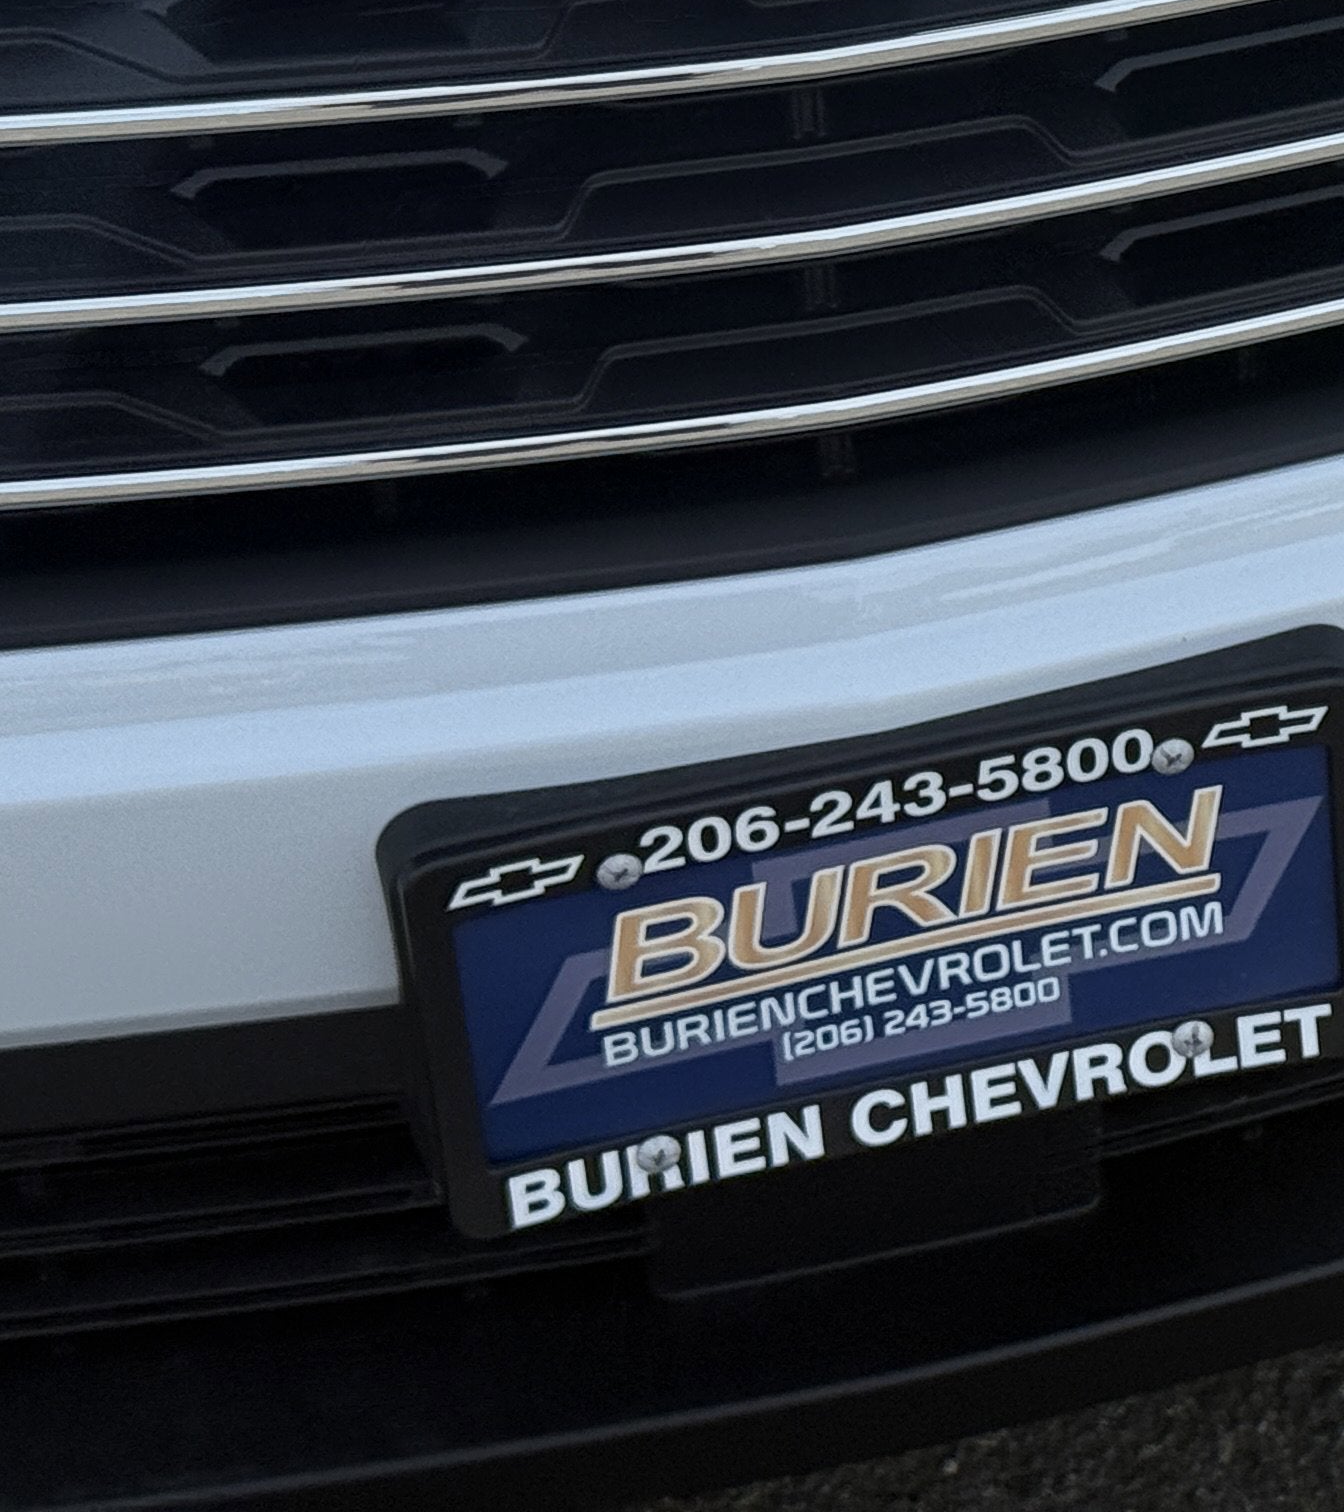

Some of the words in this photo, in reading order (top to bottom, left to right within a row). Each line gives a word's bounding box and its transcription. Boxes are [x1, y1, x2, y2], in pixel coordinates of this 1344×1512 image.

[639, 727, 1154, 875] 206-243-5800
[604, 784, 1224, 1004] BURIEN
[603, 900, 1225, 1067] BURIENCHEVROLET.COM
[782, 1015, 875, 1062] (206)
[883, 976, 1061, 1036] 243-5800
[850, 1002, 1333, 1148] CHEVROLET
